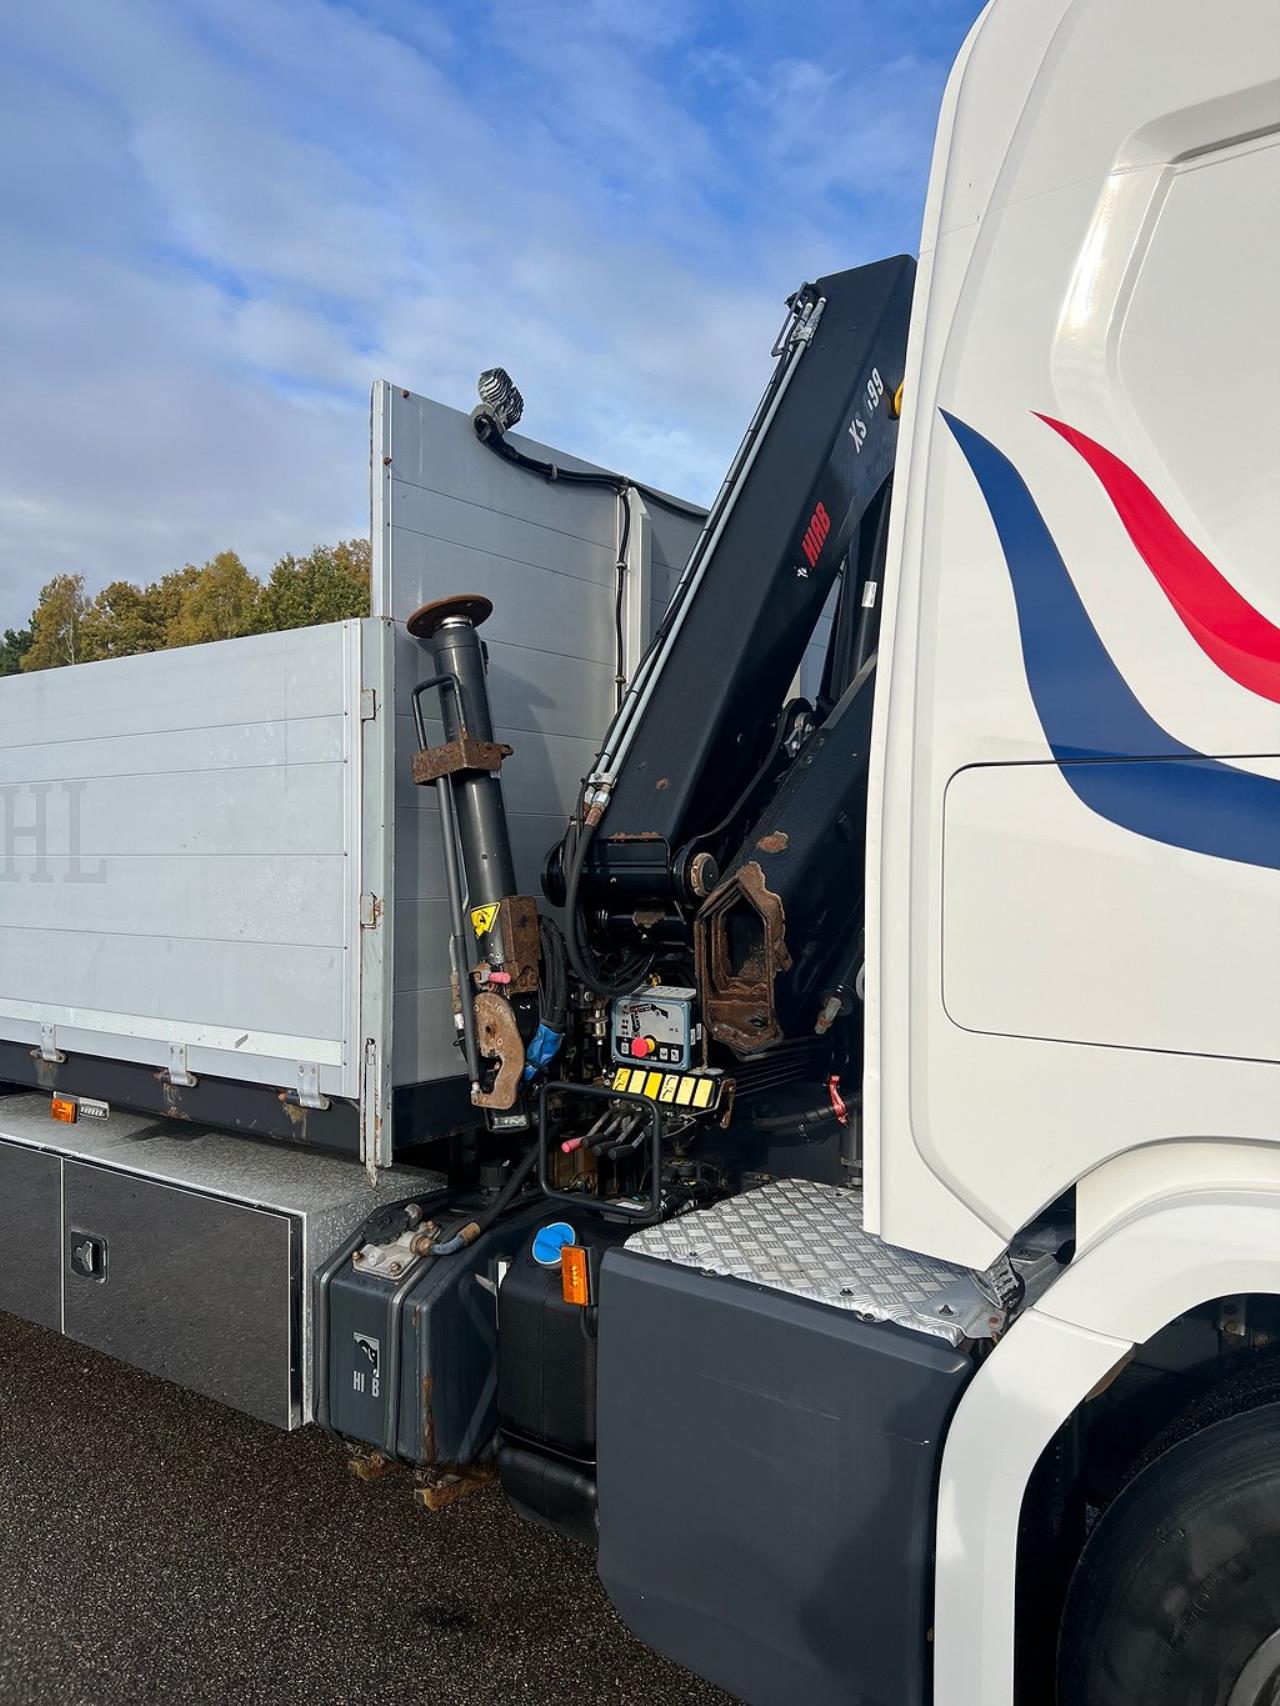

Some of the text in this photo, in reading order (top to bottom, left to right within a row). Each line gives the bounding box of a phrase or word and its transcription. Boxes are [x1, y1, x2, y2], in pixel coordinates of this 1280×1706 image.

[848, 418, 867, 454] XS
[801, 501, 831, 568] HIAB
[353, 1370, 380, 1397] HIB
